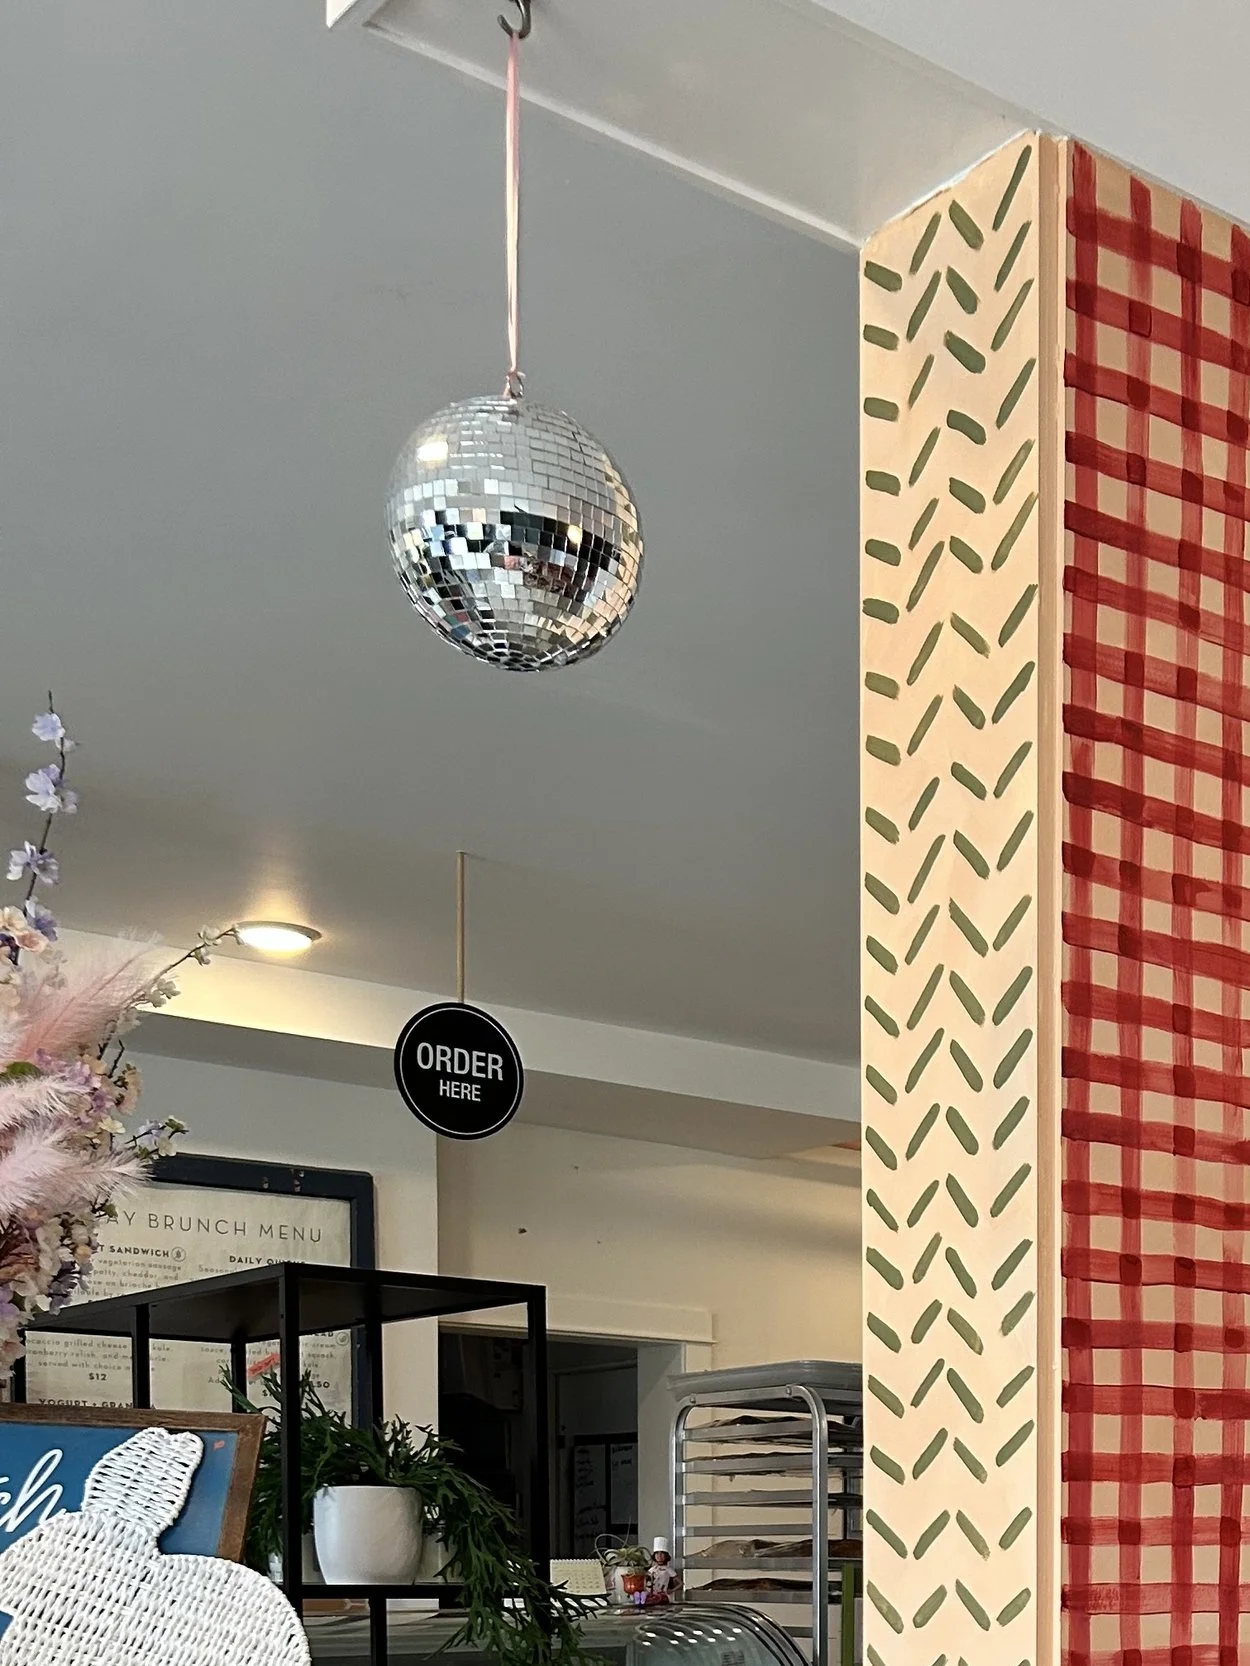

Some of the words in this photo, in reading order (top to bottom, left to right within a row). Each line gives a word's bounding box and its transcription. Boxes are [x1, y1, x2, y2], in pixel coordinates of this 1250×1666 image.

[416, 1041, 503, 1081] ORDER
[439, 1079, 482, 1102] HERE
[148, 1213, 247, 1237] BRUNCH
[259, 1223, 323, 1244] MENU
[109, 1245, 170, 1258] SANDWICH
